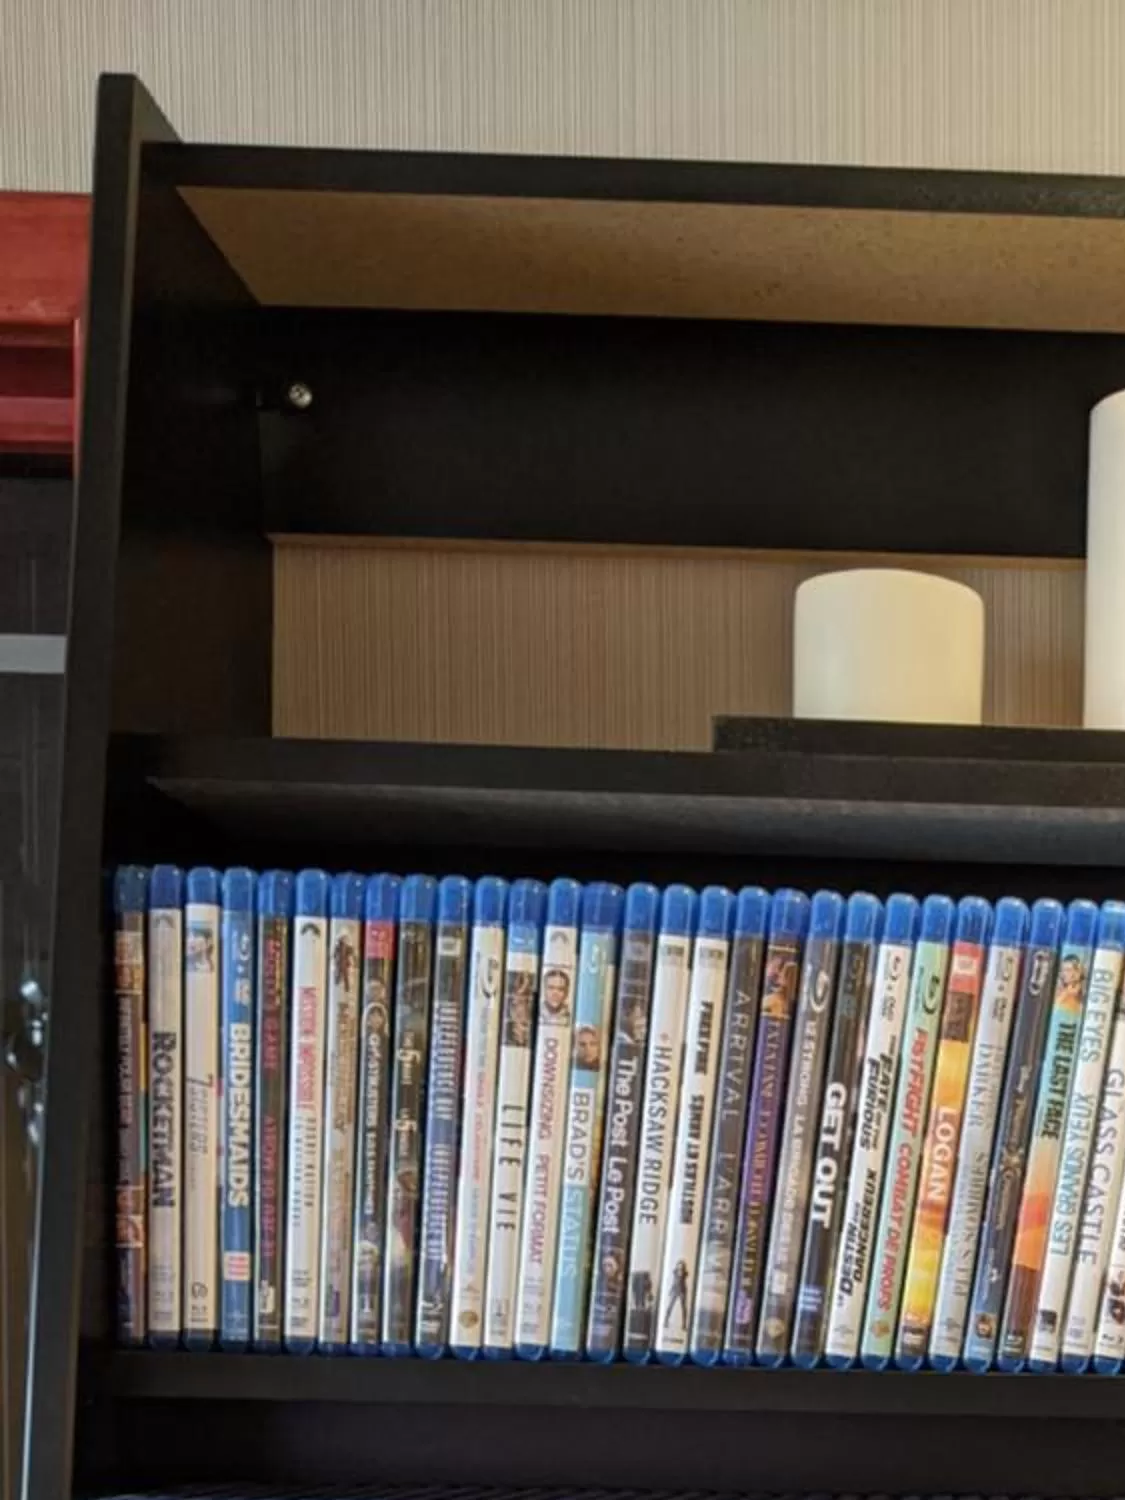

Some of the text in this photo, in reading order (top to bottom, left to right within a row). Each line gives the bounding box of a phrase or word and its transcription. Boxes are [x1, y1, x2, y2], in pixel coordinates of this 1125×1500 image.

[721, 990, 753, 1122] ARRIVAL
[1080, 968, 1115, 1062] BIG EYES
[151, 1031, 178, 1209] ROCKETMAN
[227, 1021, 252, 1208] BRIDESMAIDS
[639, 1046, 673, 1227] HACKSAW RIDGE
[860, 1059, 882, 1152] FURIOUS
[873, 1054, 896, 1108] FATE
[1040, 1023, 1078, 1139] THE LAST FACE
[496, 1104, 525, 1234] LIFE VIE
[529, 1037, 560, 1266] DOWNSIZING PETIT FORMAT
[561, 1091, 592, 1280] BRAD'S STATUS
[602, 1056, 641, 1236] The Post Le Post
[813, 1082, 851, 1230] GET OUT
[890, 1143, 914, 1224] COMBAT
[926, 1104, 958, 1203] LOGAN
[886, 1227, 902, 1251] DE
[1075, 1163, 1111, 1266] CASTLE
[878, 1257, 899, 1313] PROFS
